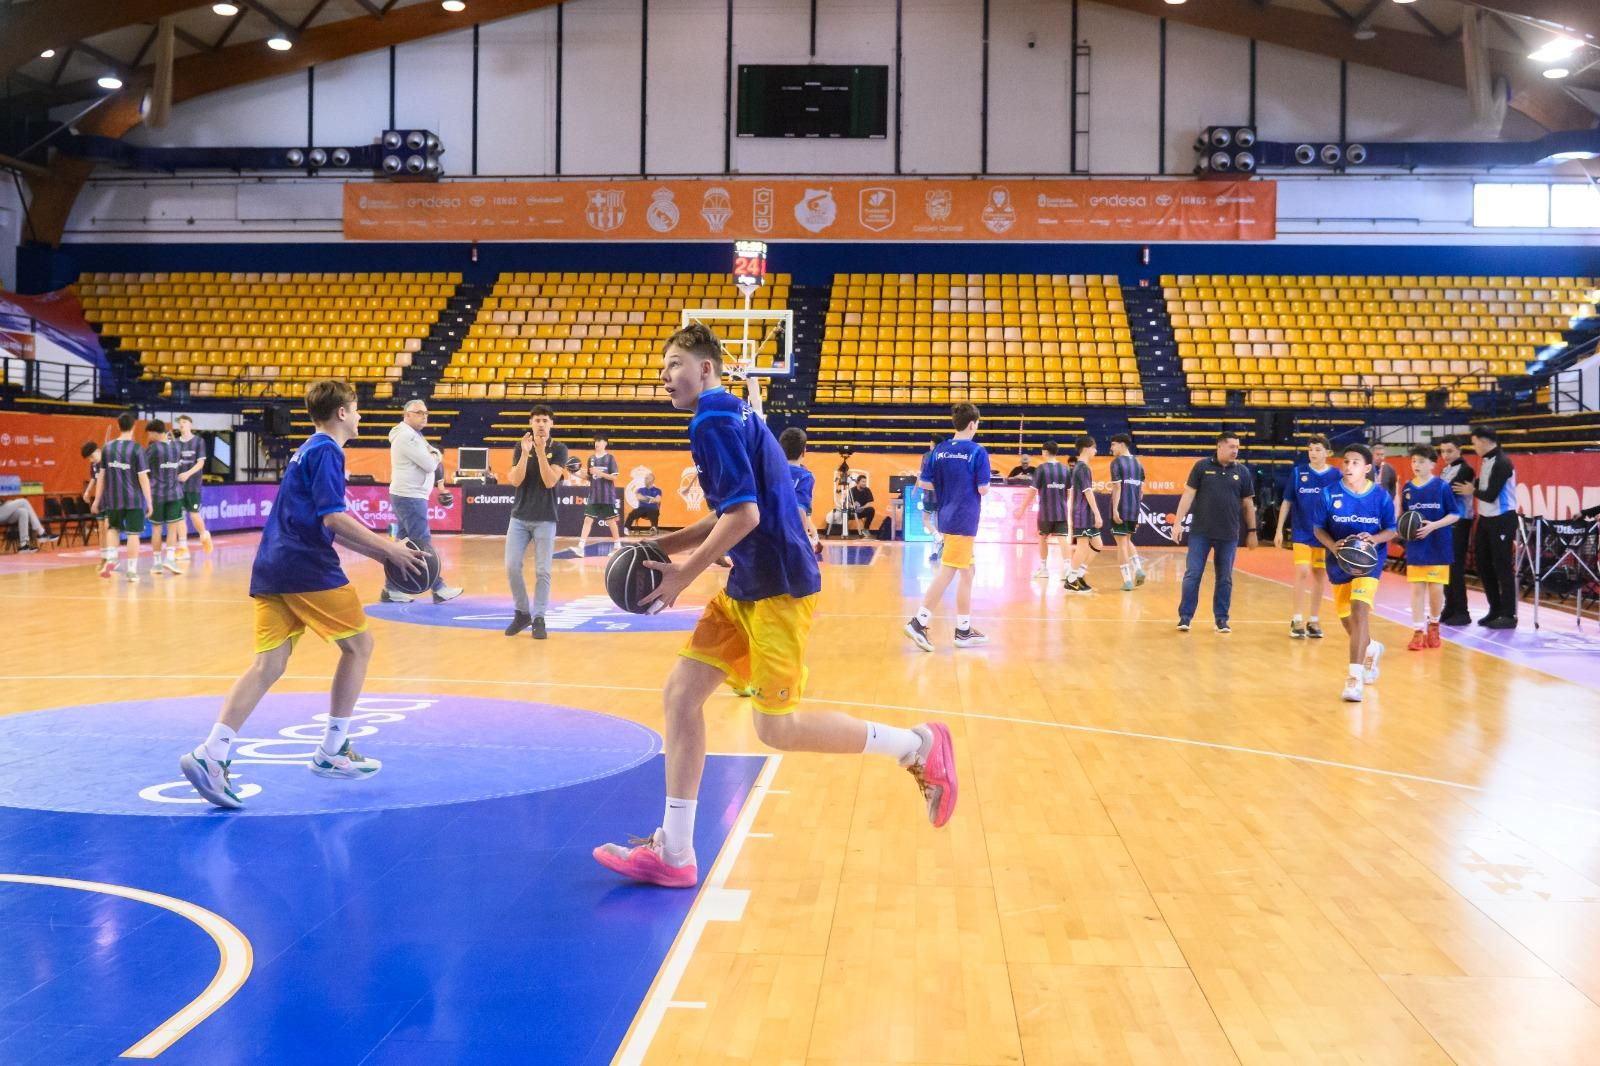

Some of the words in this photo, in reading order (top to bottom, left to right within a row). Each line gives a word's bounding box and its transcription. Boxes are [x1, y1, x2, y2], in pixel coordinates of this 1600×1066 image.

[407, 196, 461, 208] endesa
[1090, 194, 1146, 207] endesa
[735, 257, 760, 276] 24
[1149, 481, 1175, 489] IONOS
[220, 498, 256, 518] Canaria
